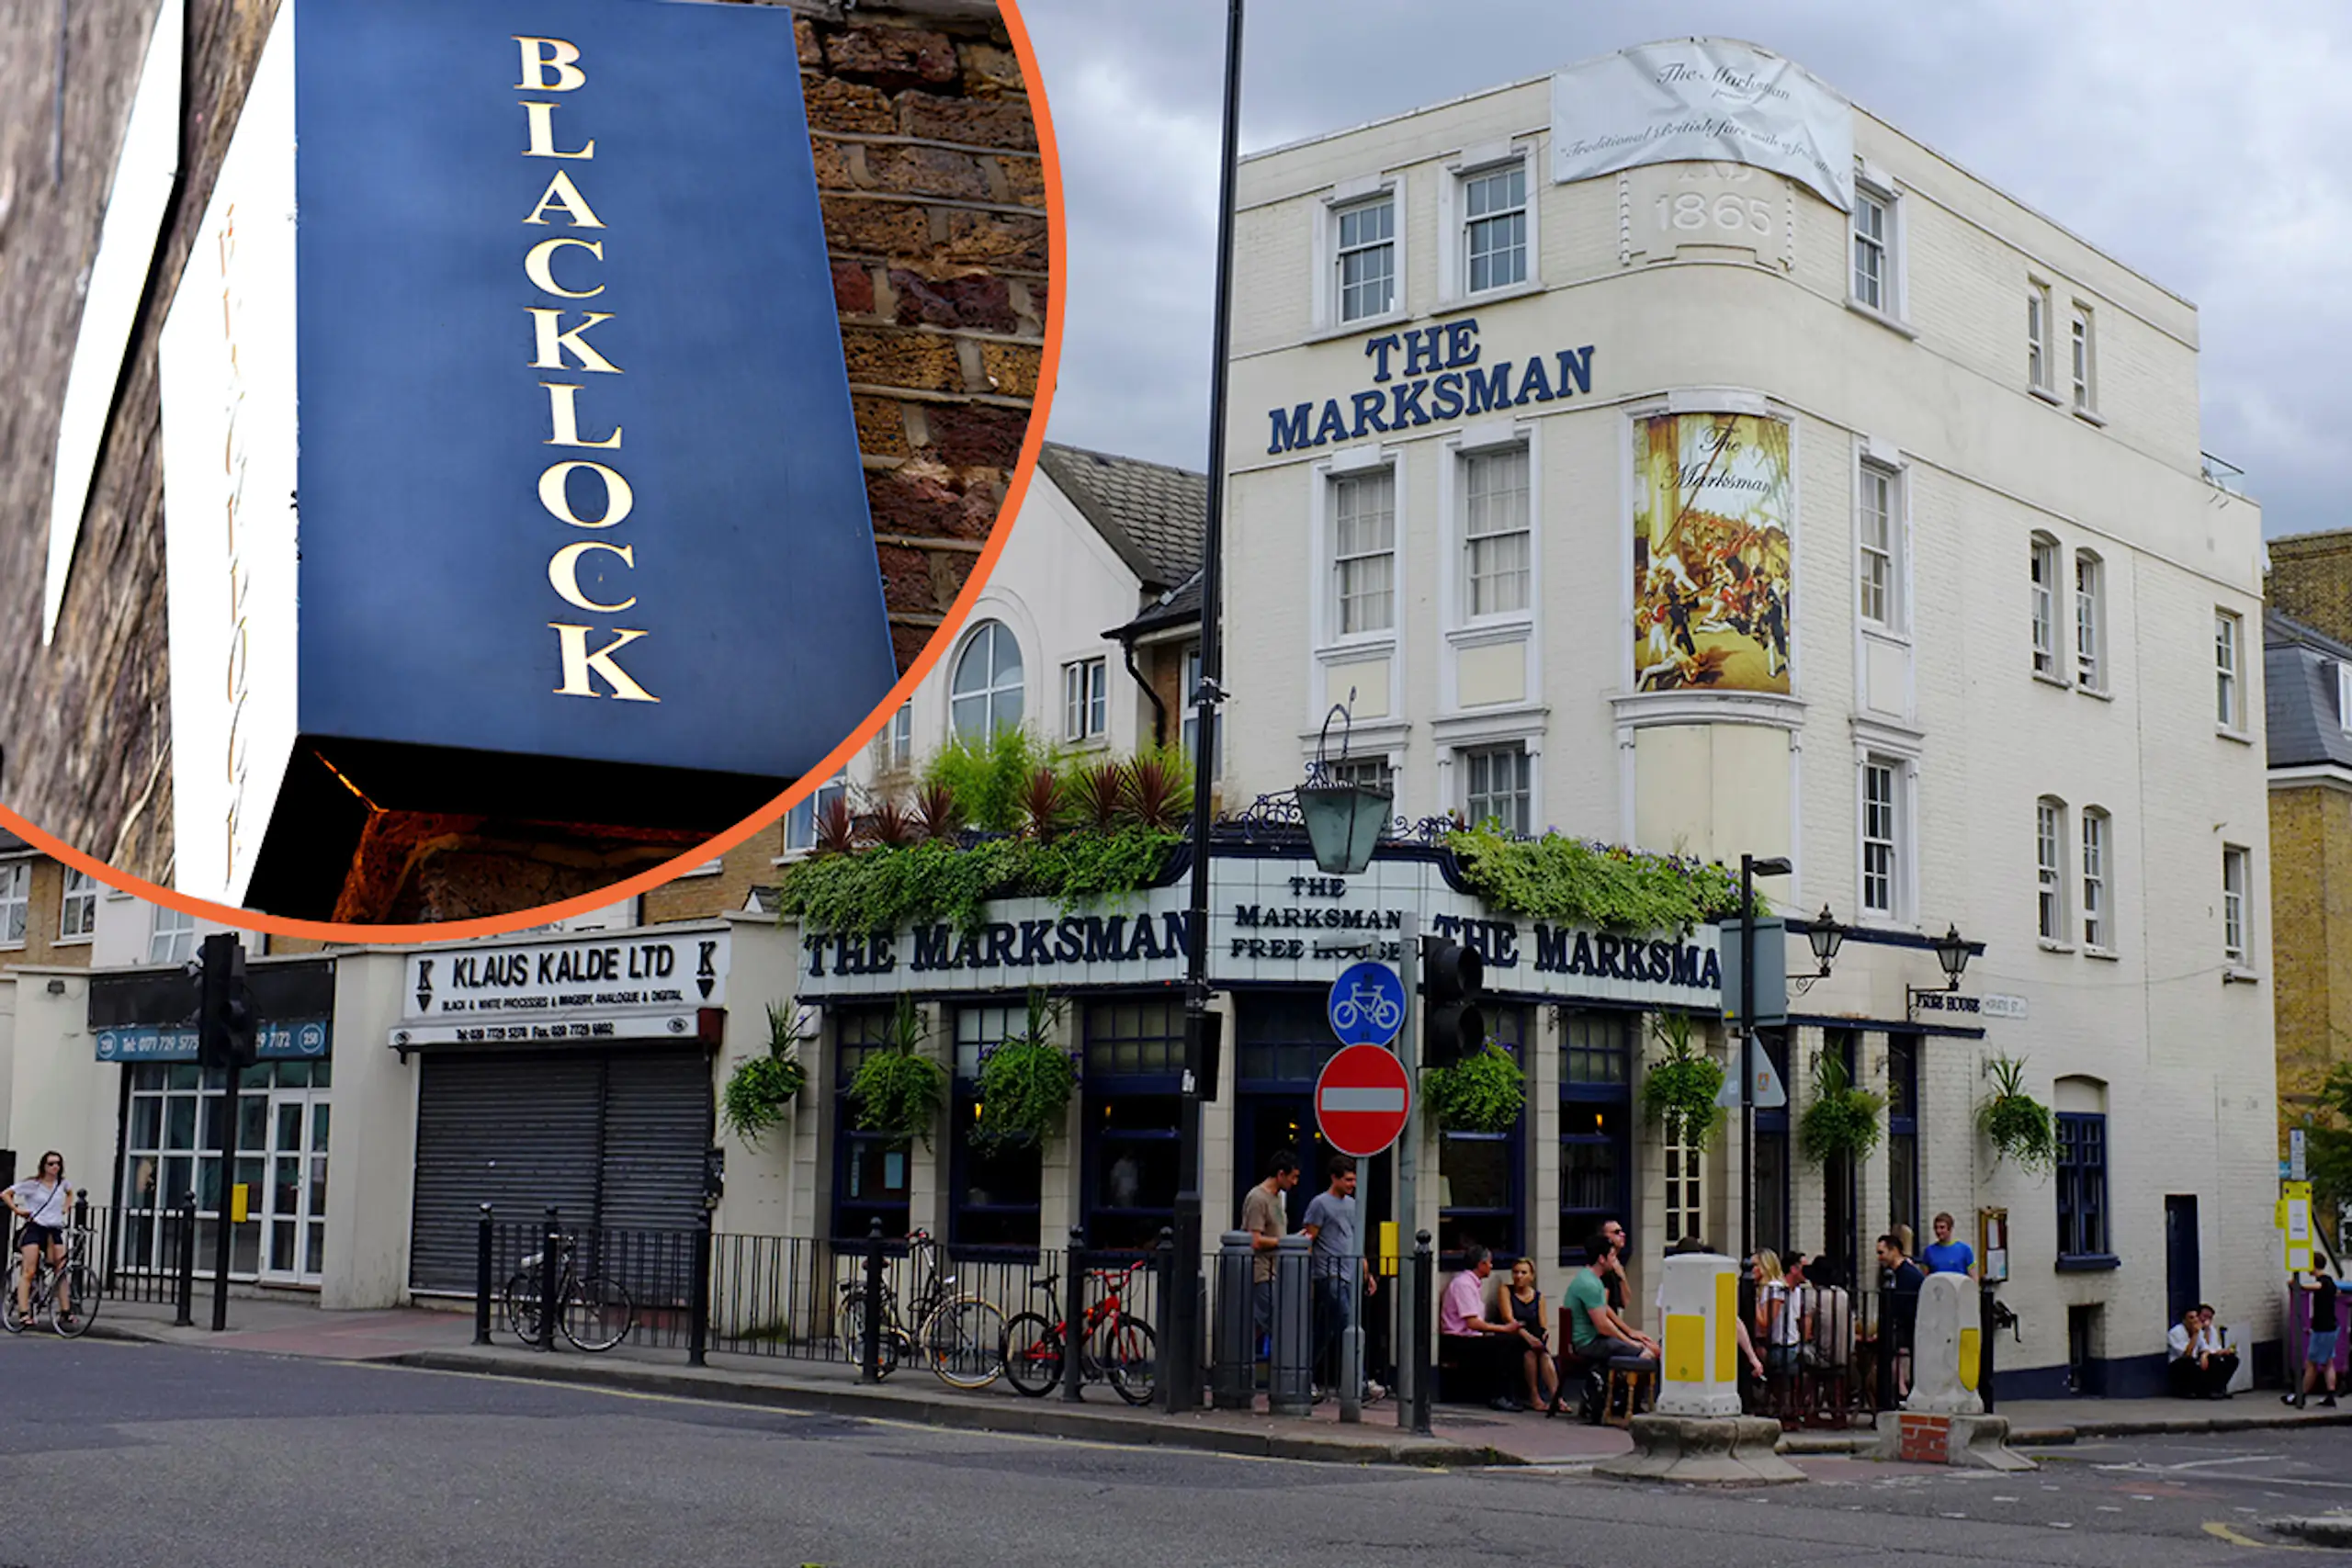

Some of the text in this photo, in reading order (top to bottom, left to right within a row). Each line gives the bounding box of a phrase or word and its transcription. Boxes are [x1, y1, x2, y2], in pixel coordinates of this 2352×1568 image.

[1657, 62, 1697, 85] The
[1655, 191, 1771, 237] 1865
[1365, 318, 1481, 382] THE
[511, 34, 661, 703] BLACKLOCK
[1267, 345, 1595, 455] MARKSMAN
[1700, 425, 1742, 453] The
[1659, 461, 1771, 494] Marksman
[1288, 876, 1347, 898] THE
[1235, 904, 1402, 930] MARKSMAN
[696, 941, 717, 976] K
[803, 910, 1192, 976] THE MARKSMAN
[1230, 938, 1305, 959] FREE
[1433, 913, 1722, 991] THE MARKSMA
[417, 960, 434, 991] K
[452, 944, 674, 989] KLAUS KALDE LTD
